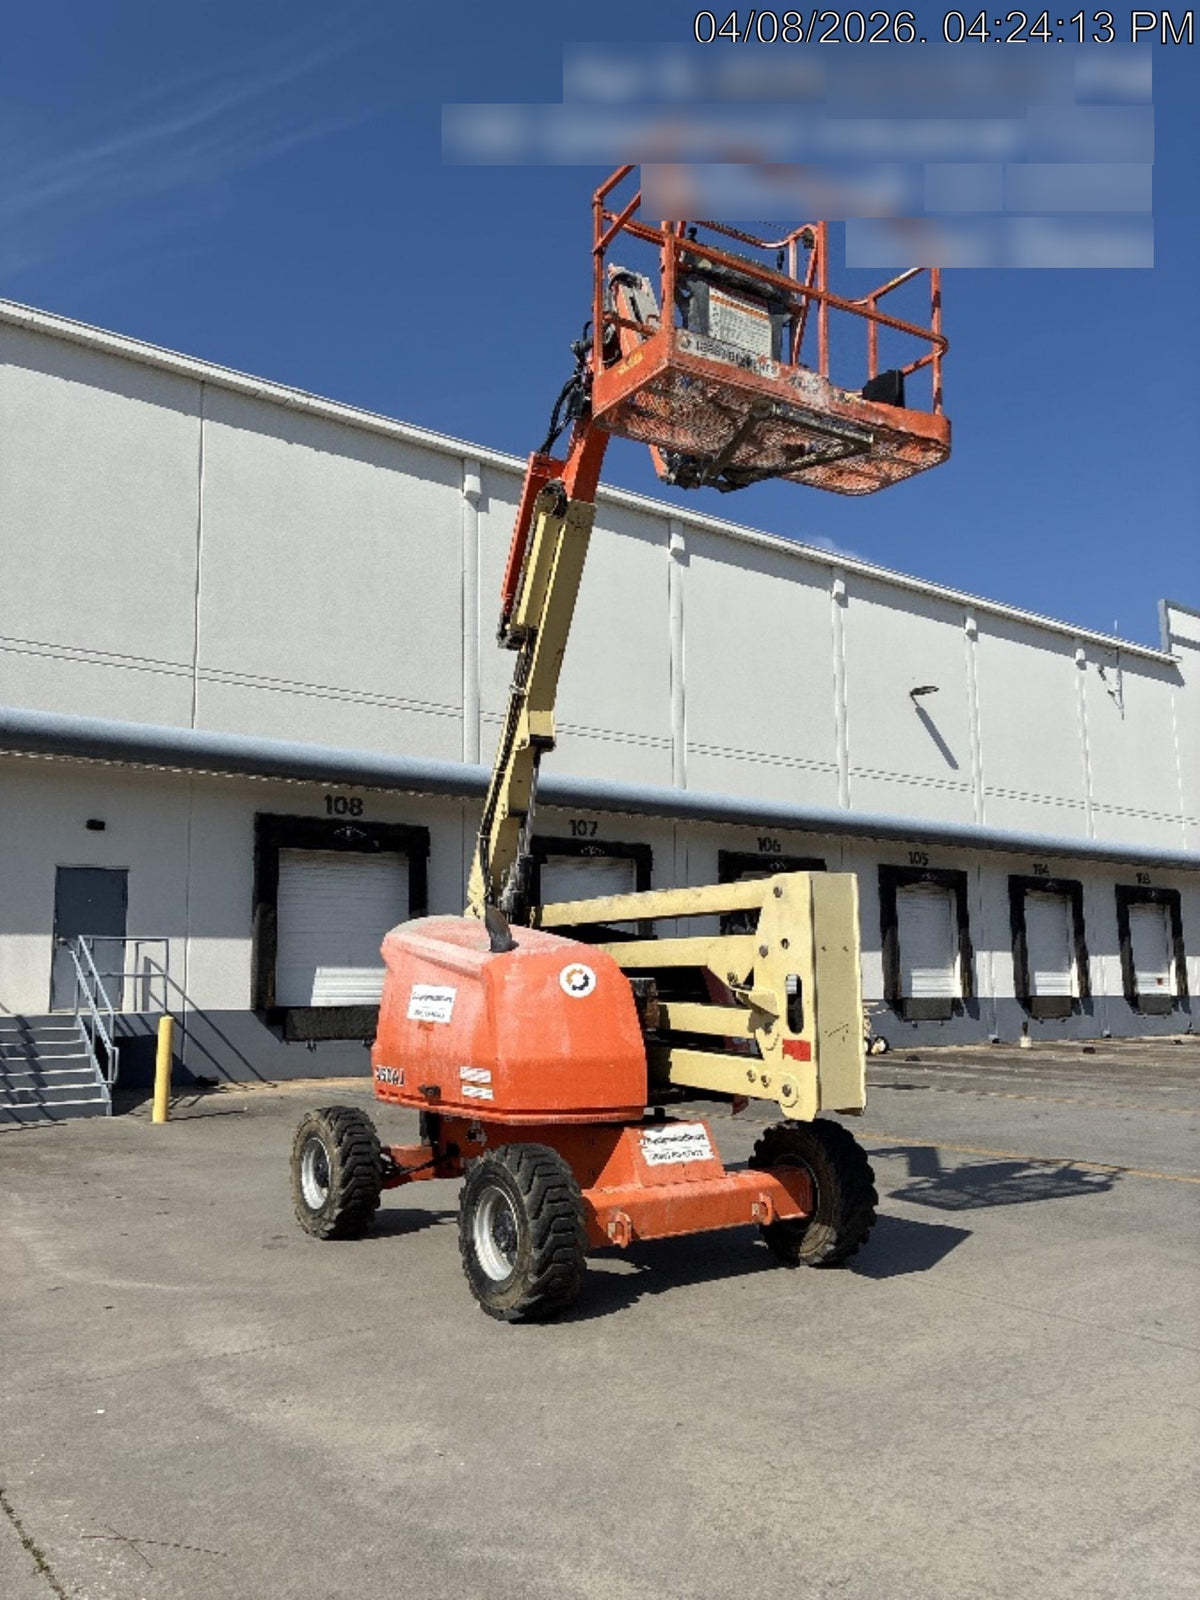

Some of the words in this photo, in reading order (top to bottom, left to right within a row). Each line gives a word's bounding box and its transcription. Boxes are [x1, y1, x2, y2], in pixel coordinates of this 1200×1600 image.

[324, 794, 363, 817] 108
[568, 819, 598, 837] 107
[757, 837, 781, 852] 106
[909, 851, 929, 867] 105
